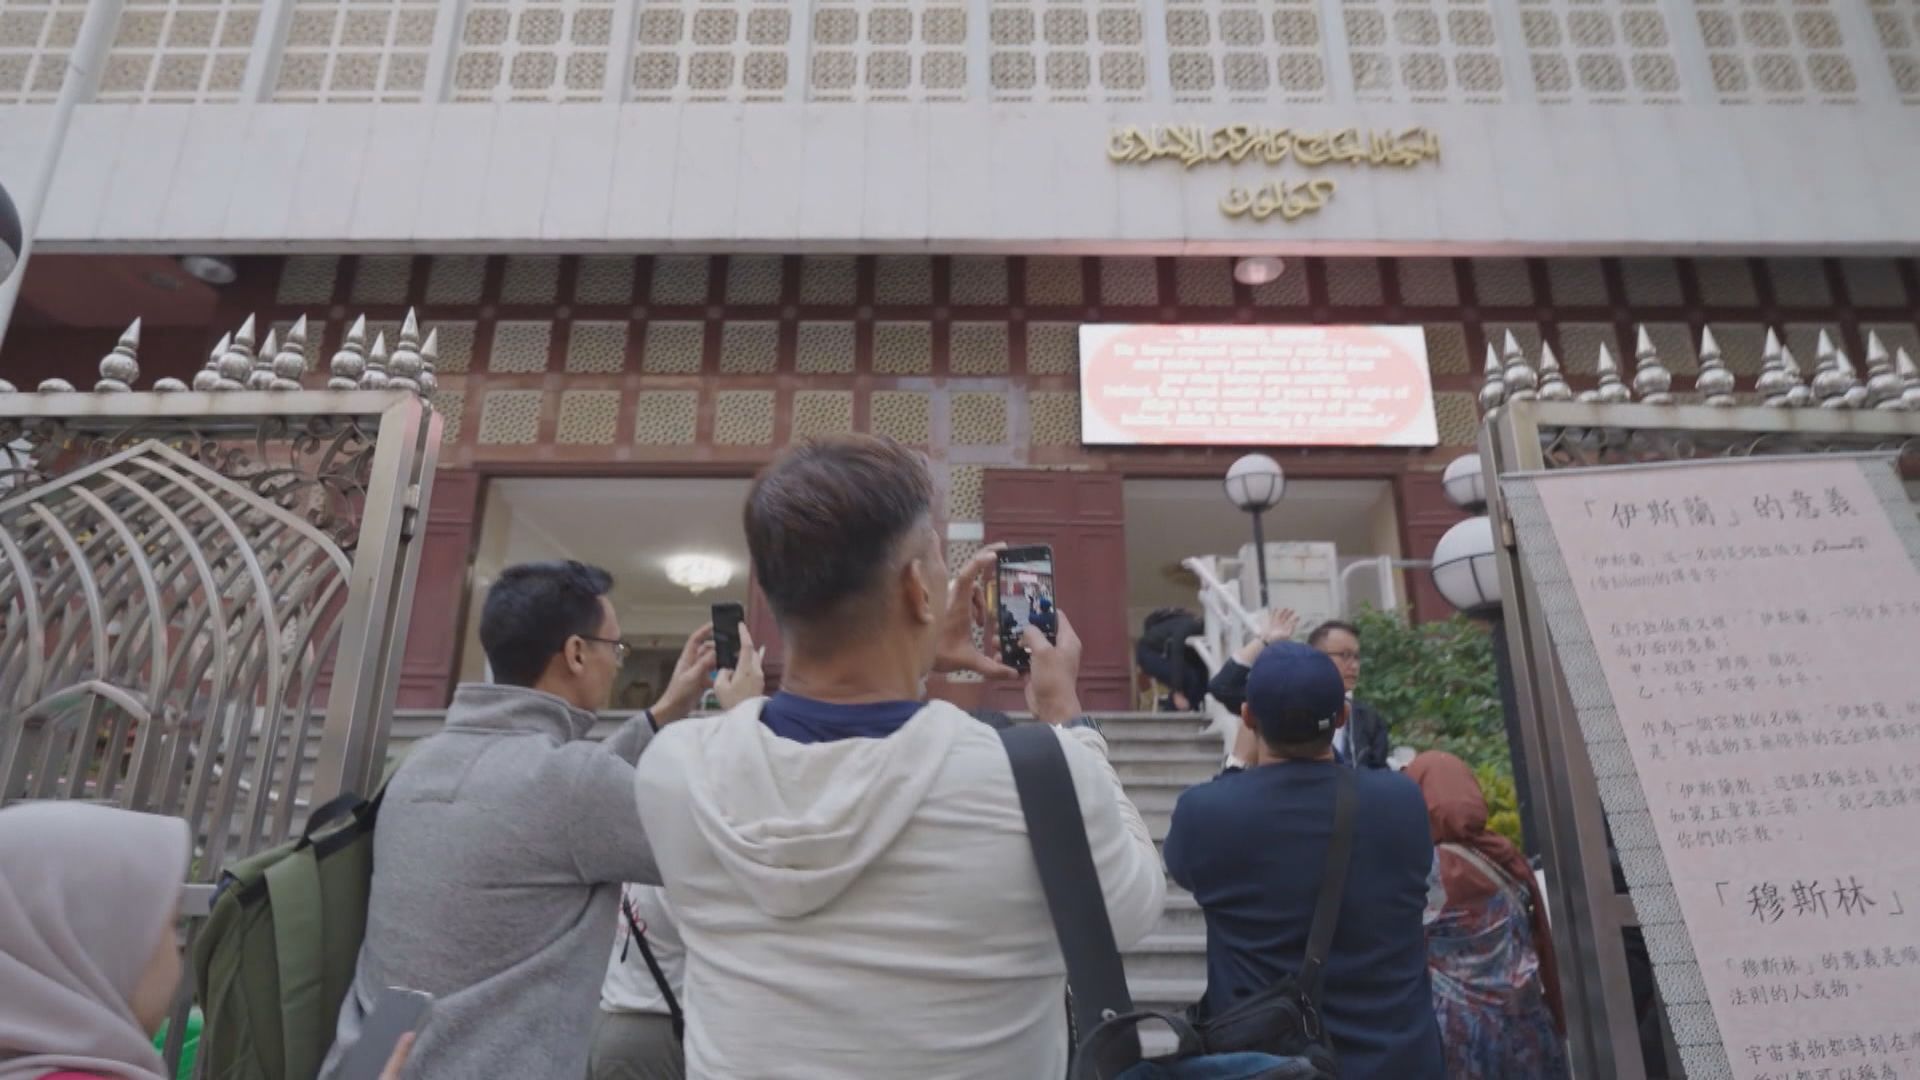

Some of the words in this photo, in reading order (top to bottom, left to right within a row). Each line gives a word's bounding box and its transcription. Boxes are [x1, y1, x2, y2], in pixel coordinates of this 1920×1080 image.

[1584, 486, 1858, 528] 「伊斯蘭」的意義
[1715, 875, 1904, 924] 「穆斯林」
